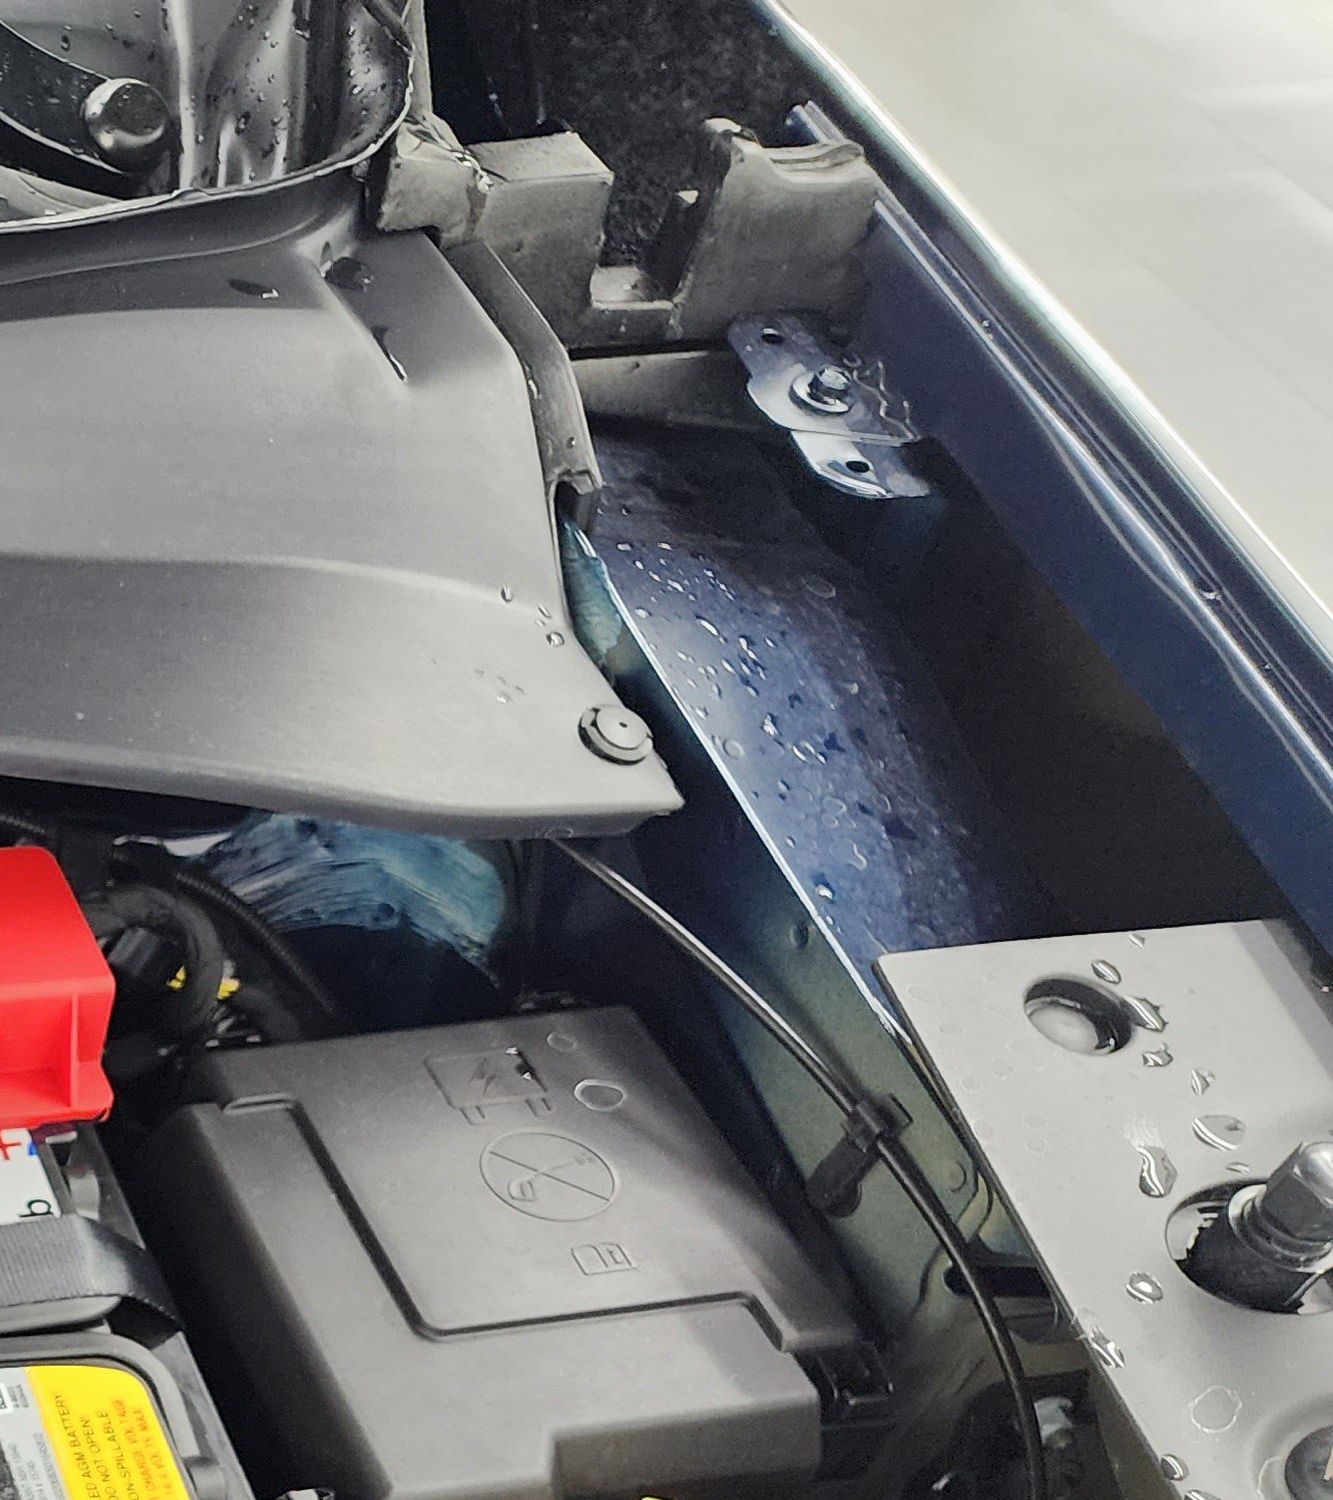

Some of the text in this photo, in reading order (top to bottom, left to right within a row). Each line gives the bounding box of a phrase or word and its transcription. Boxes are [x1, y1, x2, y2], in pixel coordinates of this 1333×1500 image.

[53, 1394, 81, 1447] BATTERY
[111, 1399, 138, 1444] VOLTAGE
[72, 1451, 92, 1478] AGM
[92, 1459, 110, 1482] NOT
[132, 1449, 155, 1491] CHARGE
